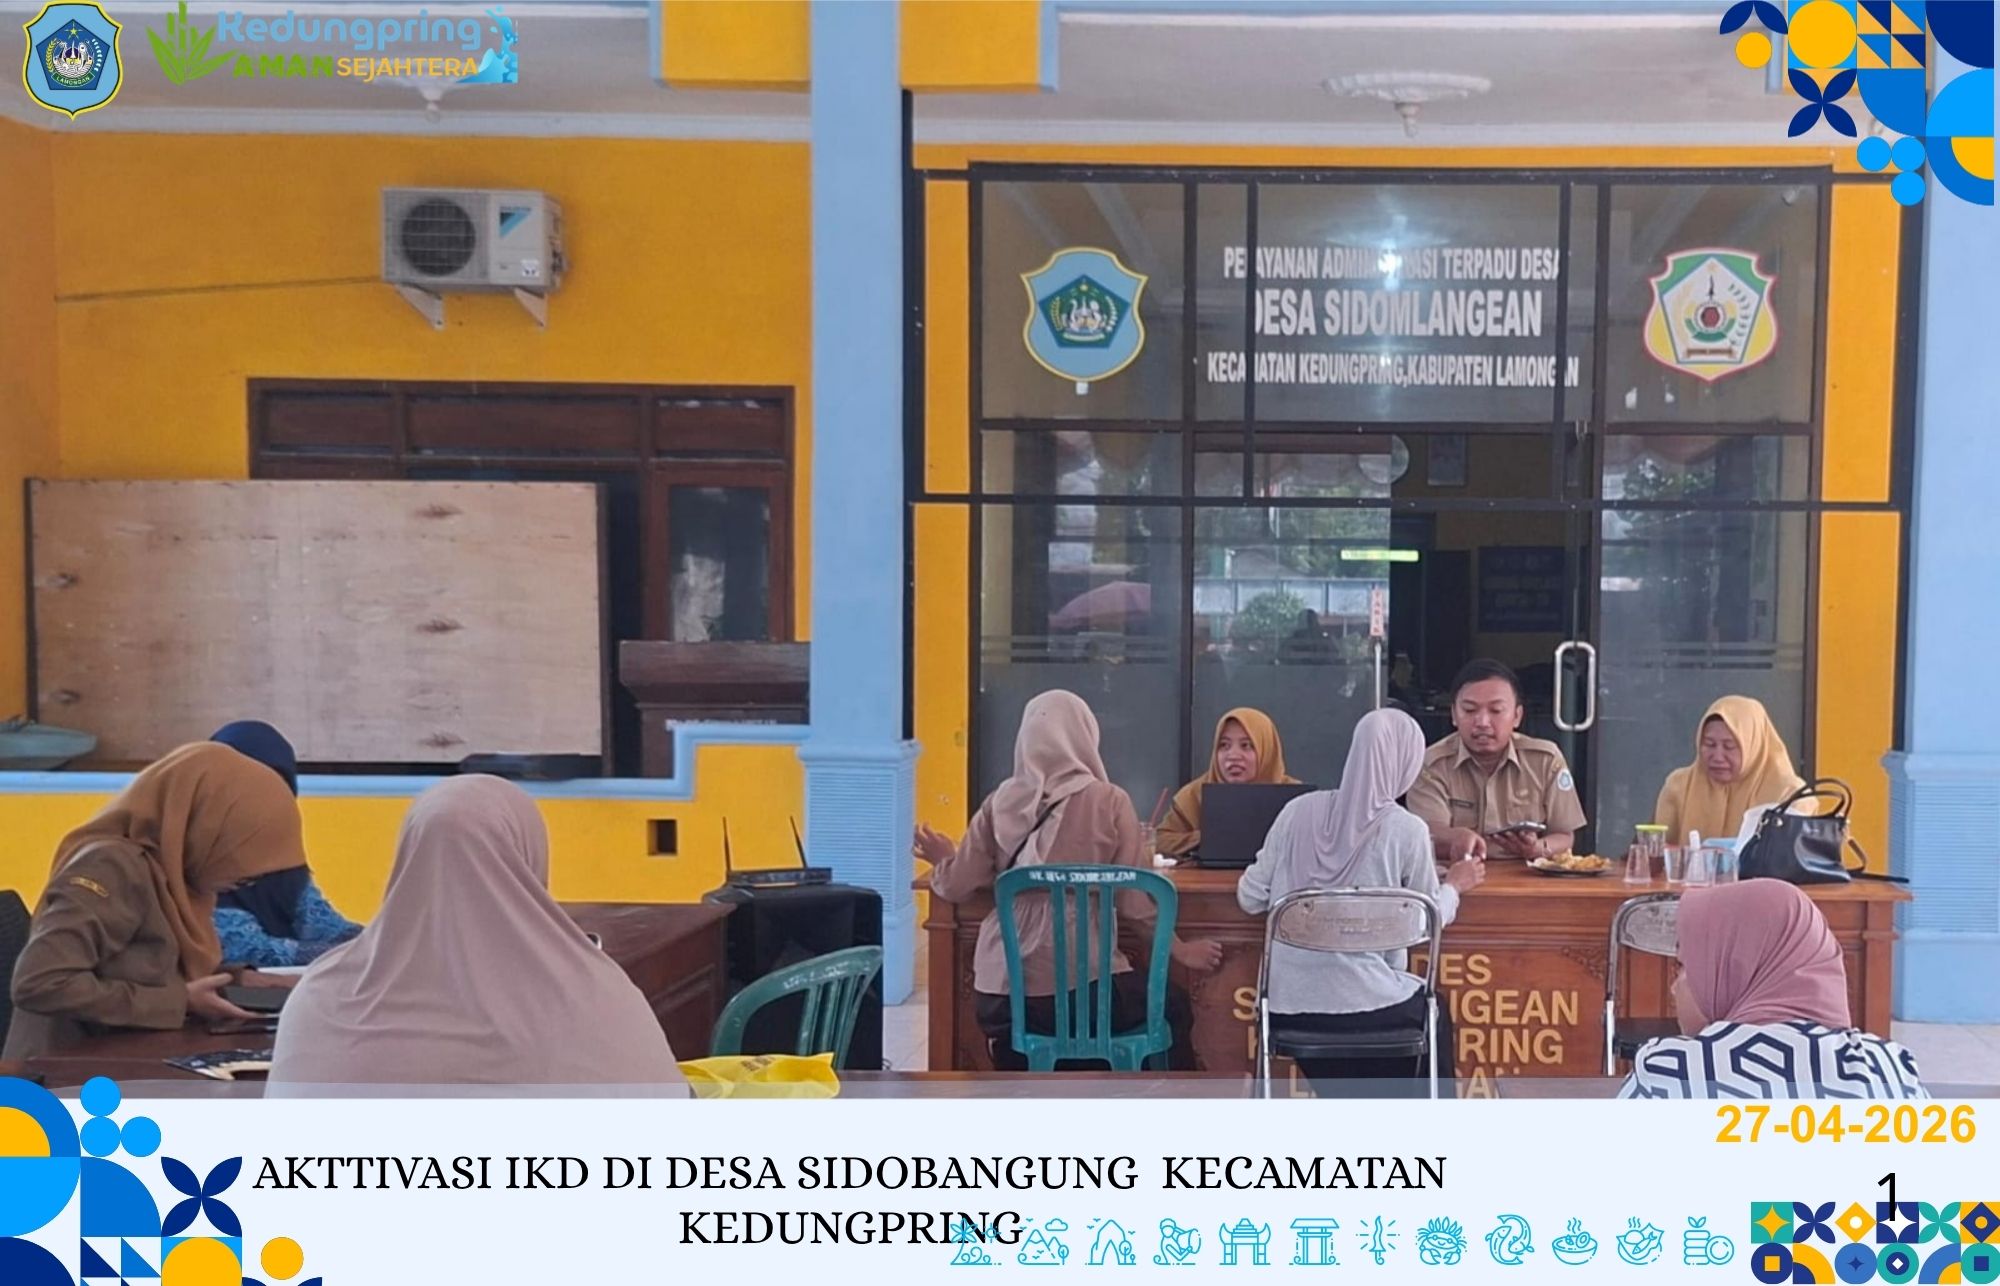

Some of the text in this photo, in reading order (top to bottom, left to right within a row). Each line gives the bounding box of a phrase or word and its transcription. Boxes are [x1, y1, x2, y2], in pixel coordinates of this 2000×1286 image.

[1224, 247, 1318, 279] PEAYANAN
[1443, 248, 1517, 280] TERPADU
[1324, 288, 1542, 337] SIDOMLANGEAN
[1208, 352, 1296, 383] KECAATAN
[1496, 355, 1579, 387] LAMONGN
